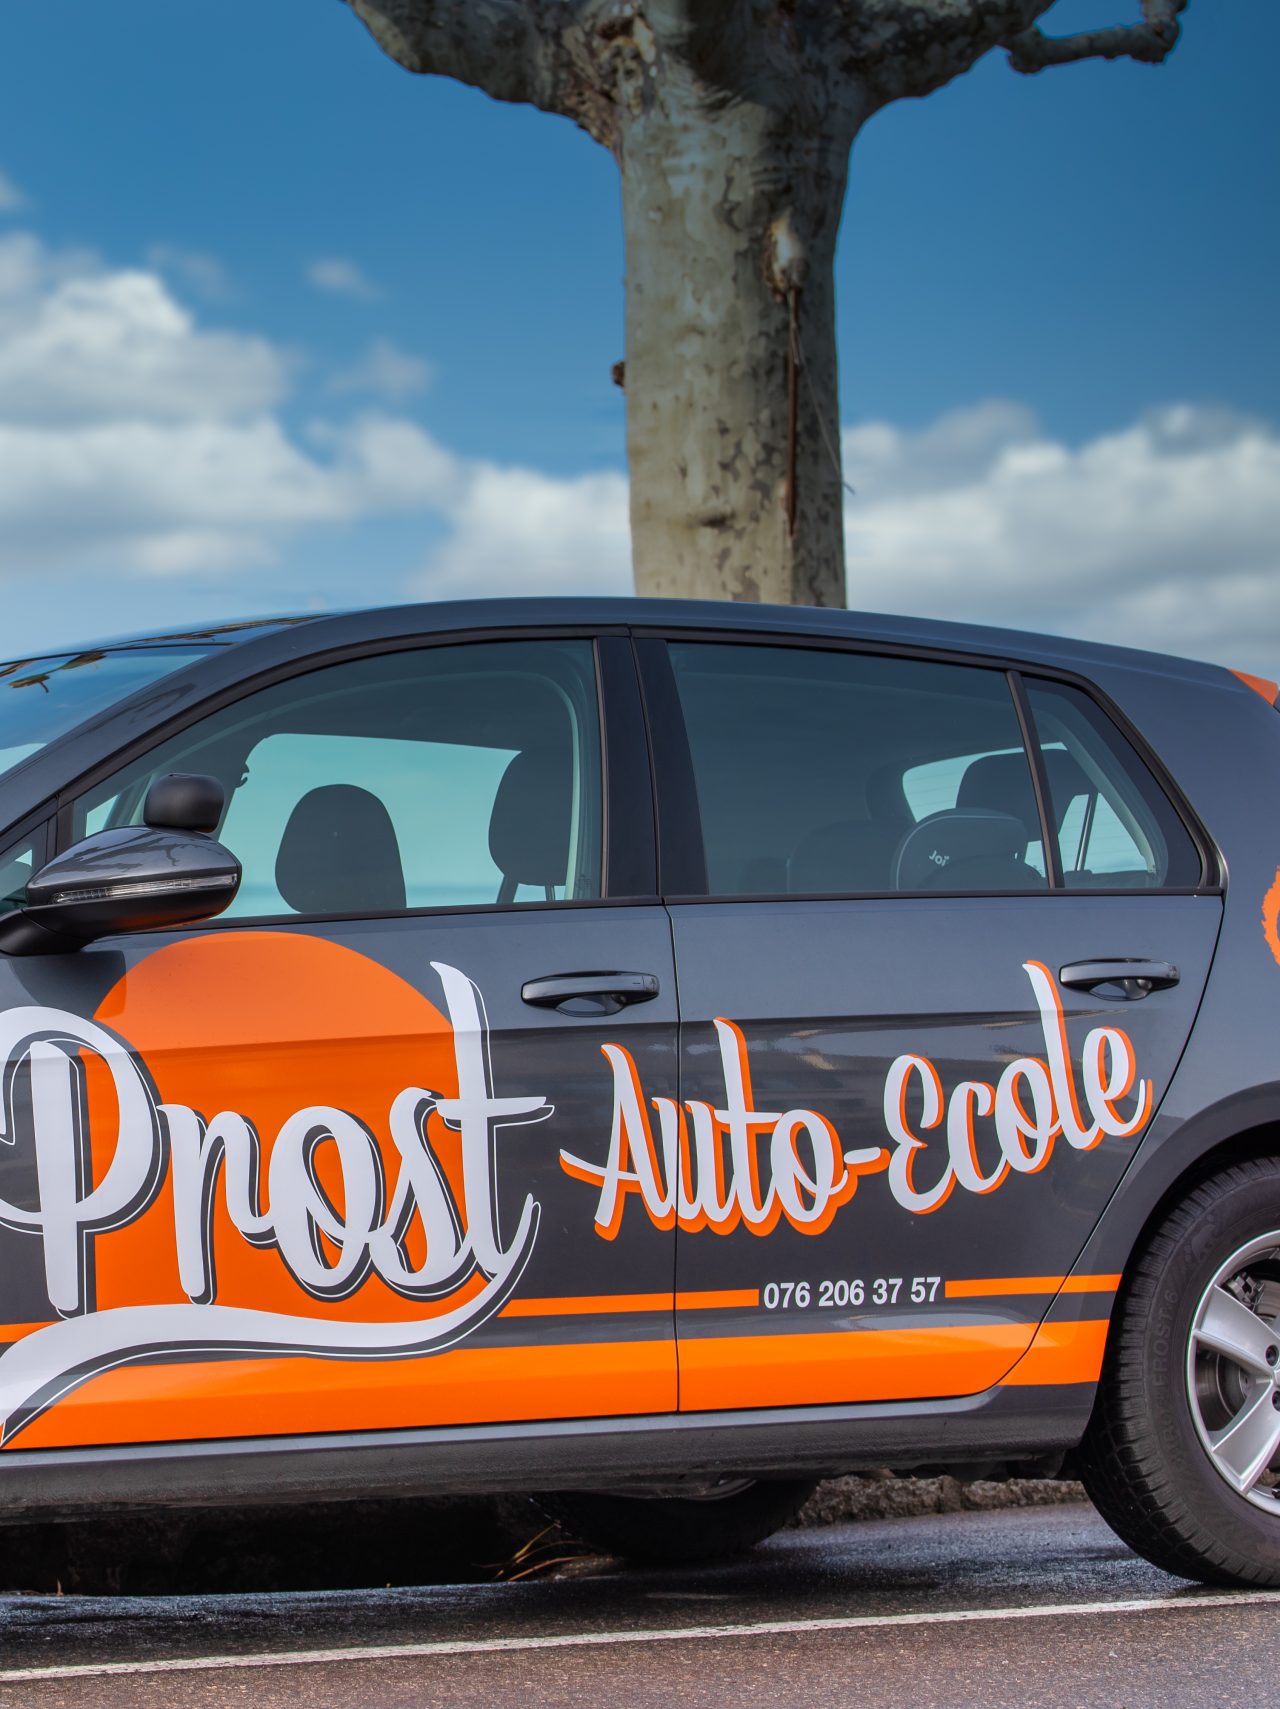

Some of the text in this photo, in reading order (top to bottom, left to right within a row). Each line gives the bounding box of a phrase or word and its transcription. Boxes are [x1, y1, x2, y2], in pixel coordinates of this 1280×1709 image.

[928, 849, 951, 868] Joi
[559, 960, 1153, 1241] Auto-Ecole
[763, 1276, 941, 1309] 076 206 37 57
